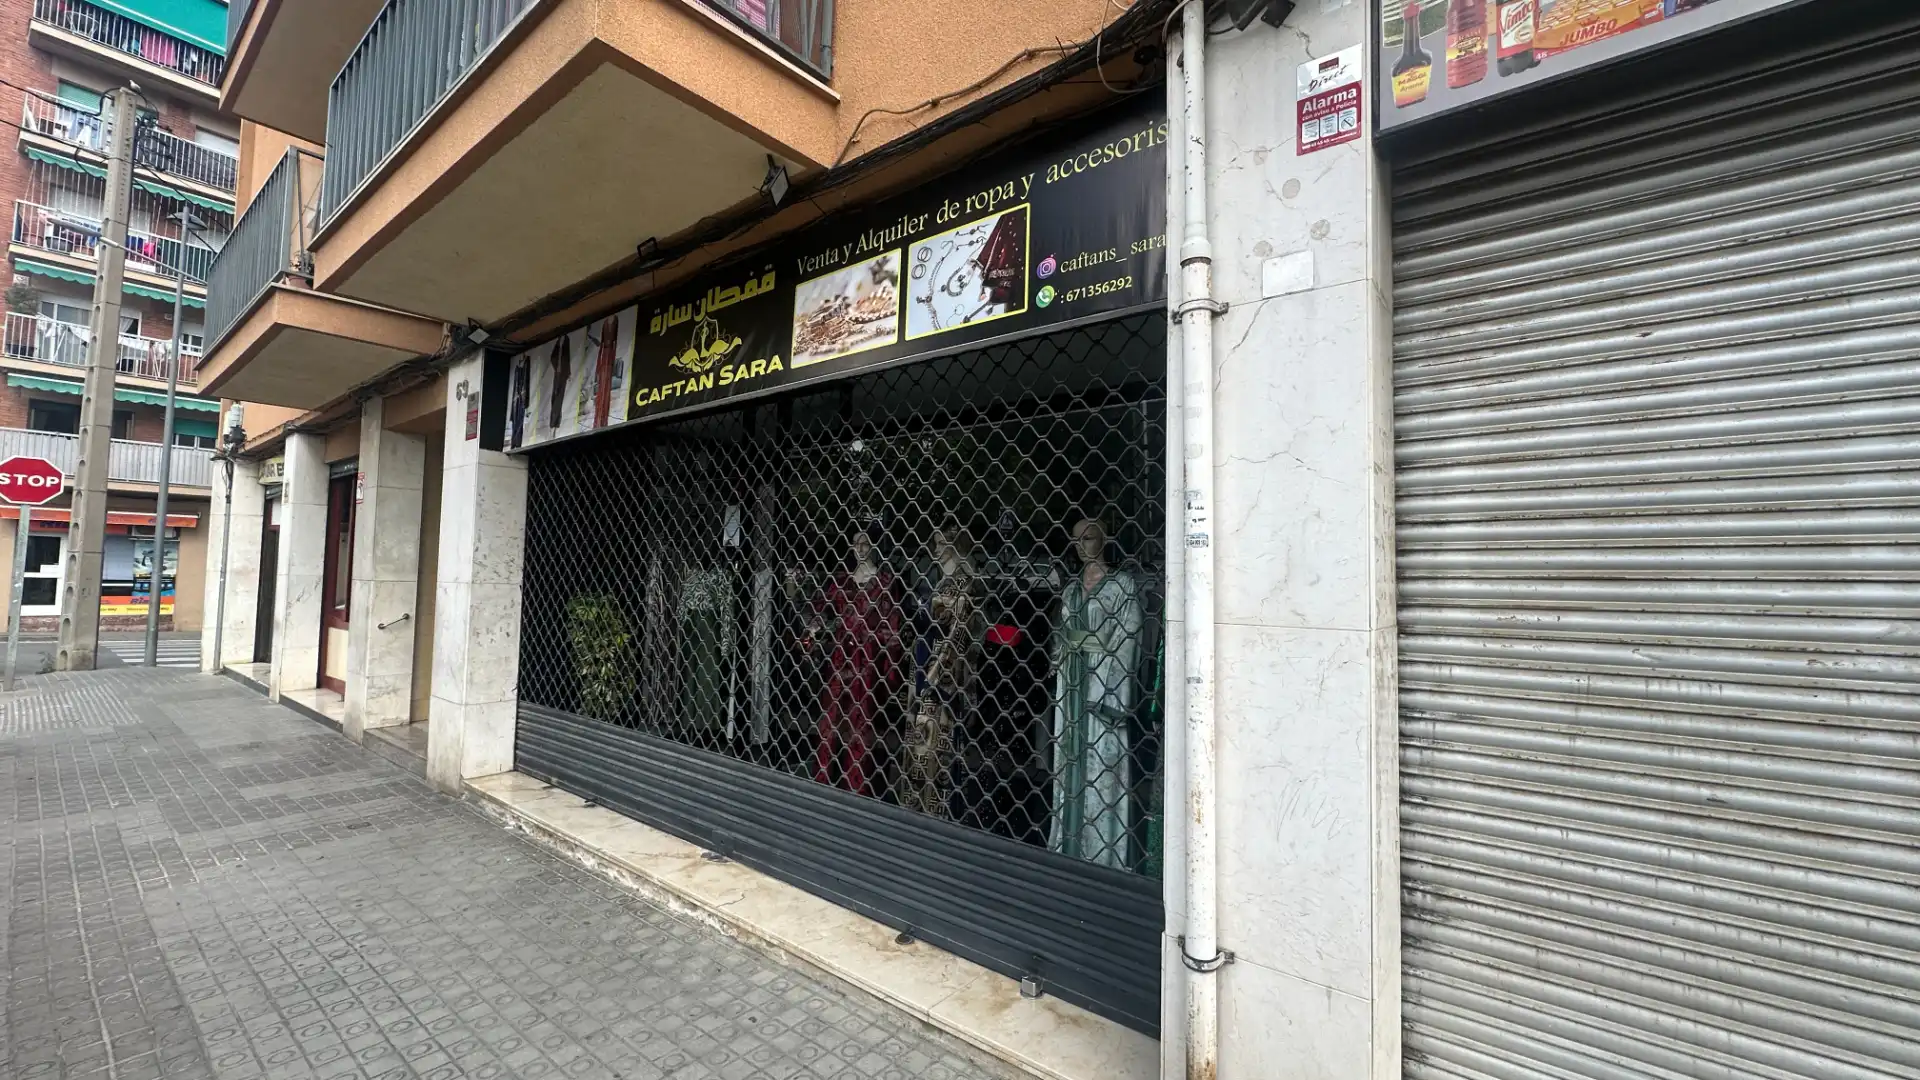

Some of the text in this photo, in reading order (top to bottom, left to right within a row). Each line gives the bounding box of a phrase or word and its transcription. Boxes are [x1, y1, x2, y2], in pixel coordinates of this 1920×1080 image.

[1559, 18, 1618, 46] JUMBO
[1308, 64, 1350, 93] Direct
[1302, 88, 1357, 115] Alarma
[797, 248, 839, 275] Venta
[842, 242, 852, 265] y
[855, 213, 929, 255] Alquiler
[936, 198, 960, 224] de
[965, 180, 1015, 213] ropa
[1020, 172, 1035, 200] y
[650, 303, 692, 337] سارة
[456, 379, 469, 401] 69
[635, 354, 784, 407] CAFTAN SARA
[0, 472, 60, 488] STOP
